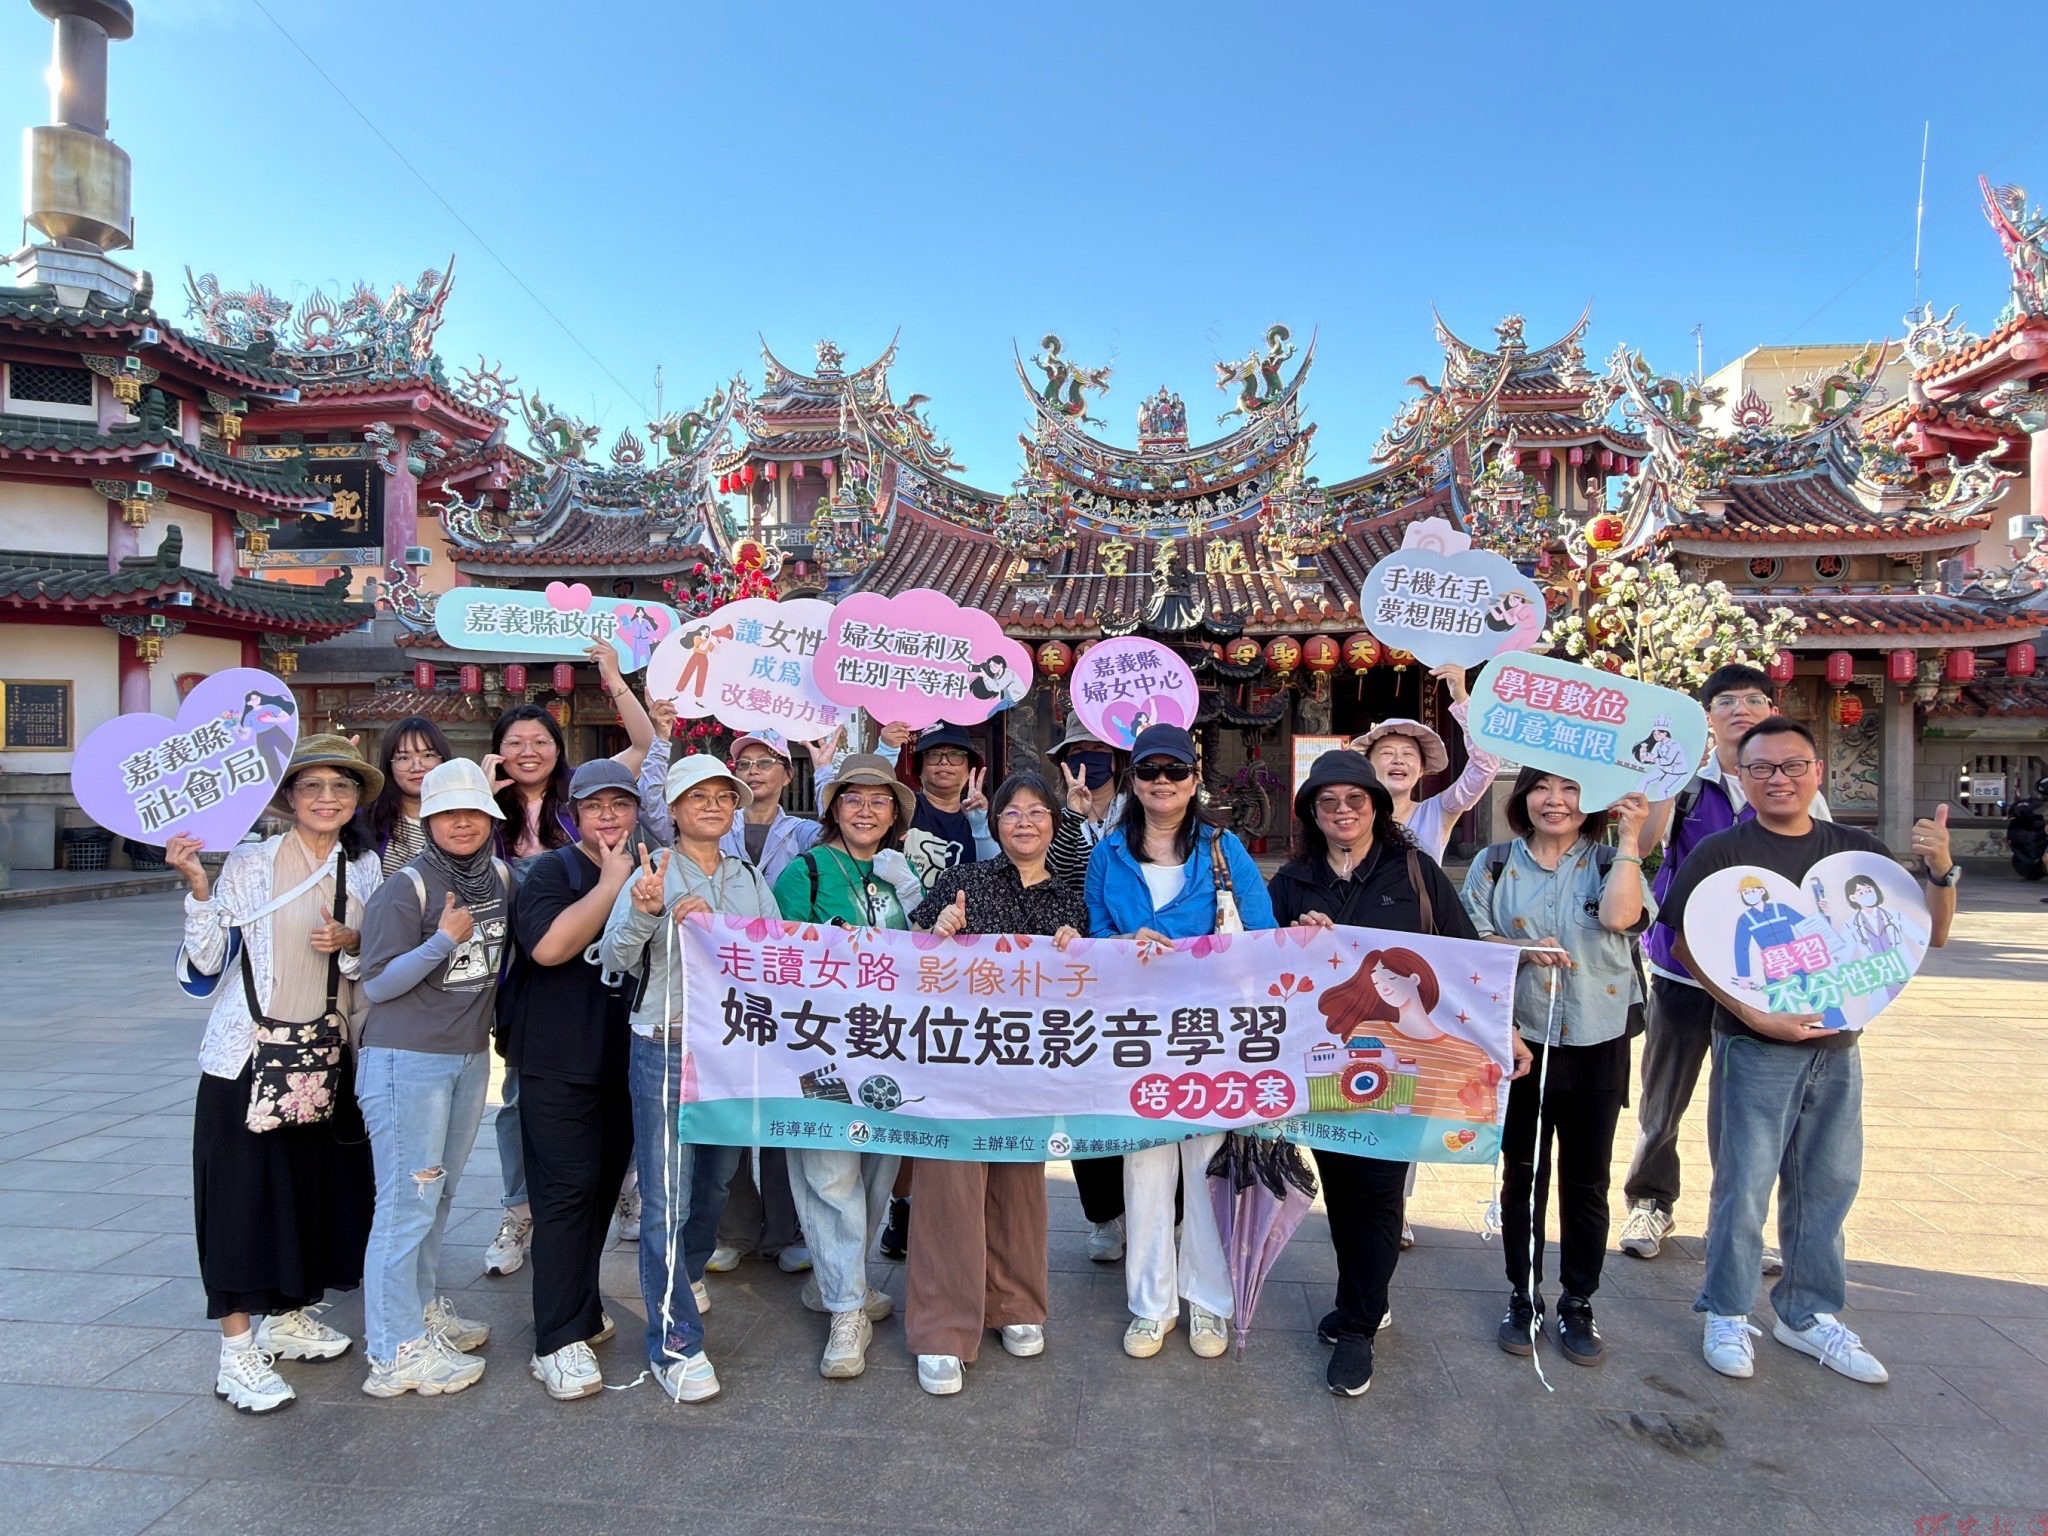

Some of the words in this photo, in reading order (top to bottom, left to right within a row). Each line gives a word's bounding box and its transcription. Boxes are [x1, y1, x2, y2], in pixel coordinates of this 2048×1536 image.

[1384, 567, 1490, 603] 手機在手
[466, 604, 617, 639] 嘉義縣政府
[1377, 597, 1484, 634] 夢想開拍
[735, 618, 828, 656] 讓女性
[840, 621, 972, 663] 婦女福利及
[1271, 642, 1298, 668] 聖
[1311, 643, 1335, 665] 上
[1349, 640, 1376, 664] 天
[1039, 646, 1064, 671] 年
[1091, 649, 1163, 679] 嘉義縣
[836, 658, 968, 698] 性別平等科
[1082, 670, 1183, 704] 婦女中心
[1496, 669, 1626, 723] 學習數位
[721, 683, 840, 727] 改變的力量
[1484, 706, 1615, 762] 創意無限
[122, 720, 231, 791] 嘉義縣
[137, 749, 265, 830] 社會局
[717, 942, 900, 992] 走讀女路
[916, 957, 1098, 999] 影像朴子
[1763, 936, 1828, 978] 學習
[1765, 952, 1908, 1012] 不分性別
[722, 987, 1288, 1069] 婦女數位短影音學習
[1136, 1075, 1290, 1112] 培力方案
[872, 1126, 950, 1149] 嘉義縣政府
